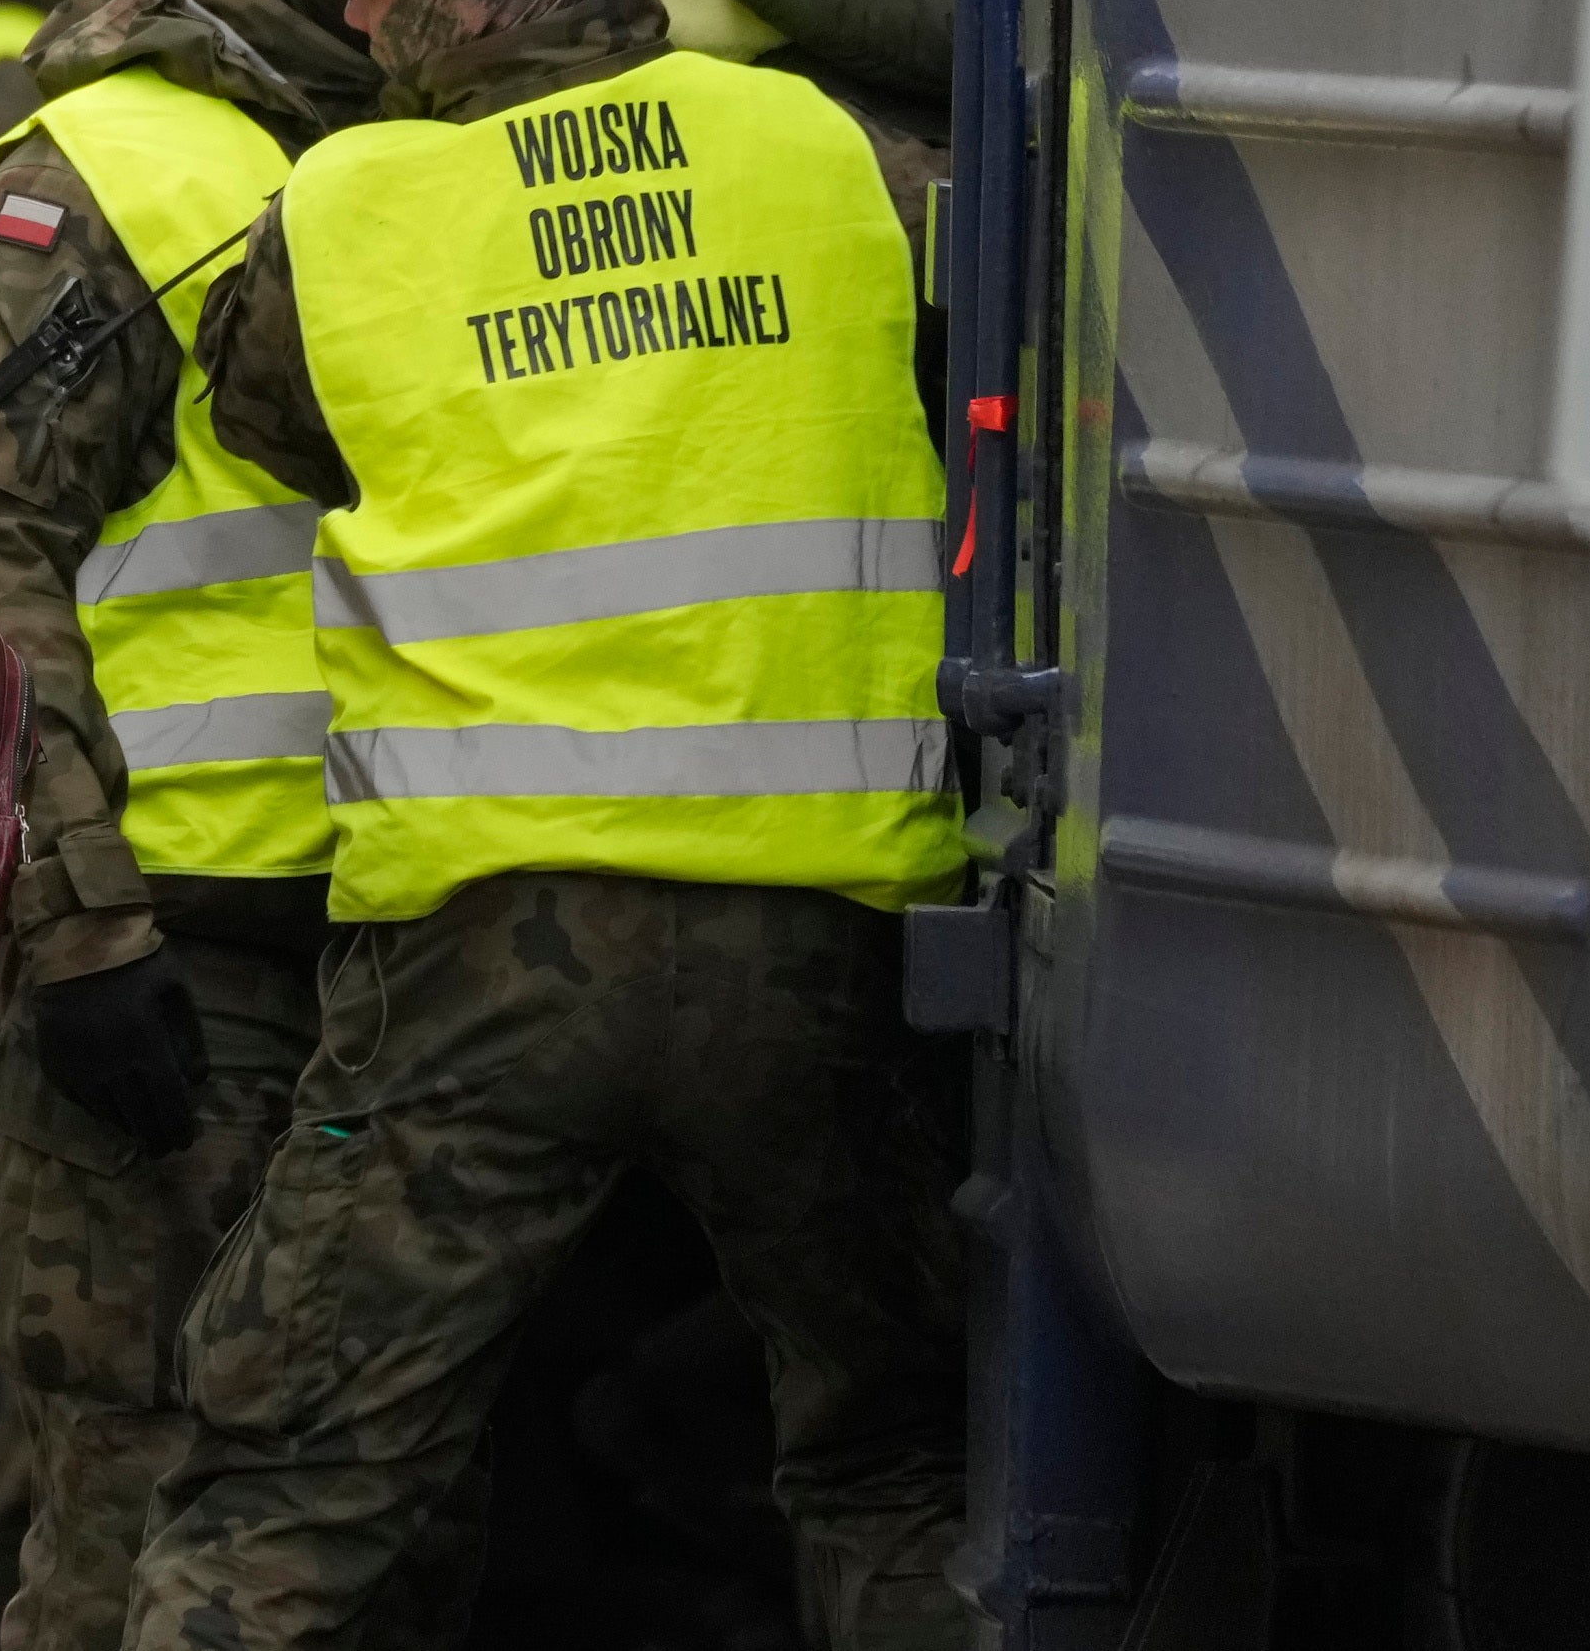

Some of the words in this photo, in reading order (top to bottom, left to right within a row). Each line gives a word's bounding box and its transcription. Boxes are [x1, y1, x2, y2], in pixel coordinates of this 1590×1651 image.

[505, 101, 689, 189] WOJSKA
[529, 189, 697, 280] OBRONY
[467, 274, 790, 384] TERYTORIALNEJ
